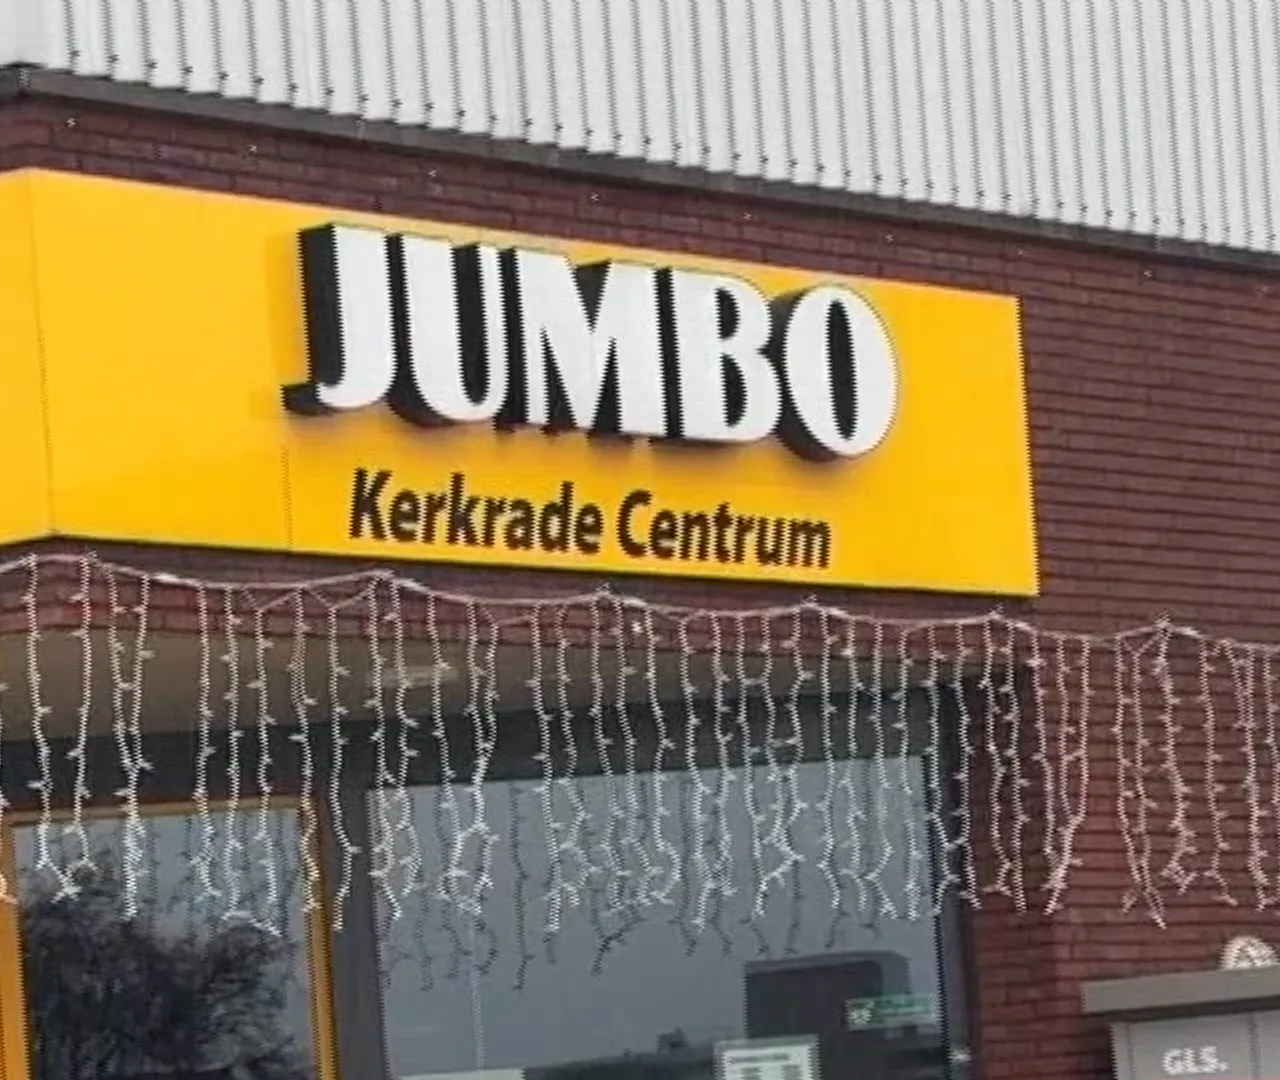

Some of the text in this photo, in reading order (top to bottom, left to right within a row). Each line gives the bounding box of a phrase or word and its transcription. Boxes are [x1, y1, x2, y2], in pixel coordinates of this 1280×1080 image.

[282, 222, 899, 461] JUMBO
[349, 467, 832, 569] Kerkrade Centrum
